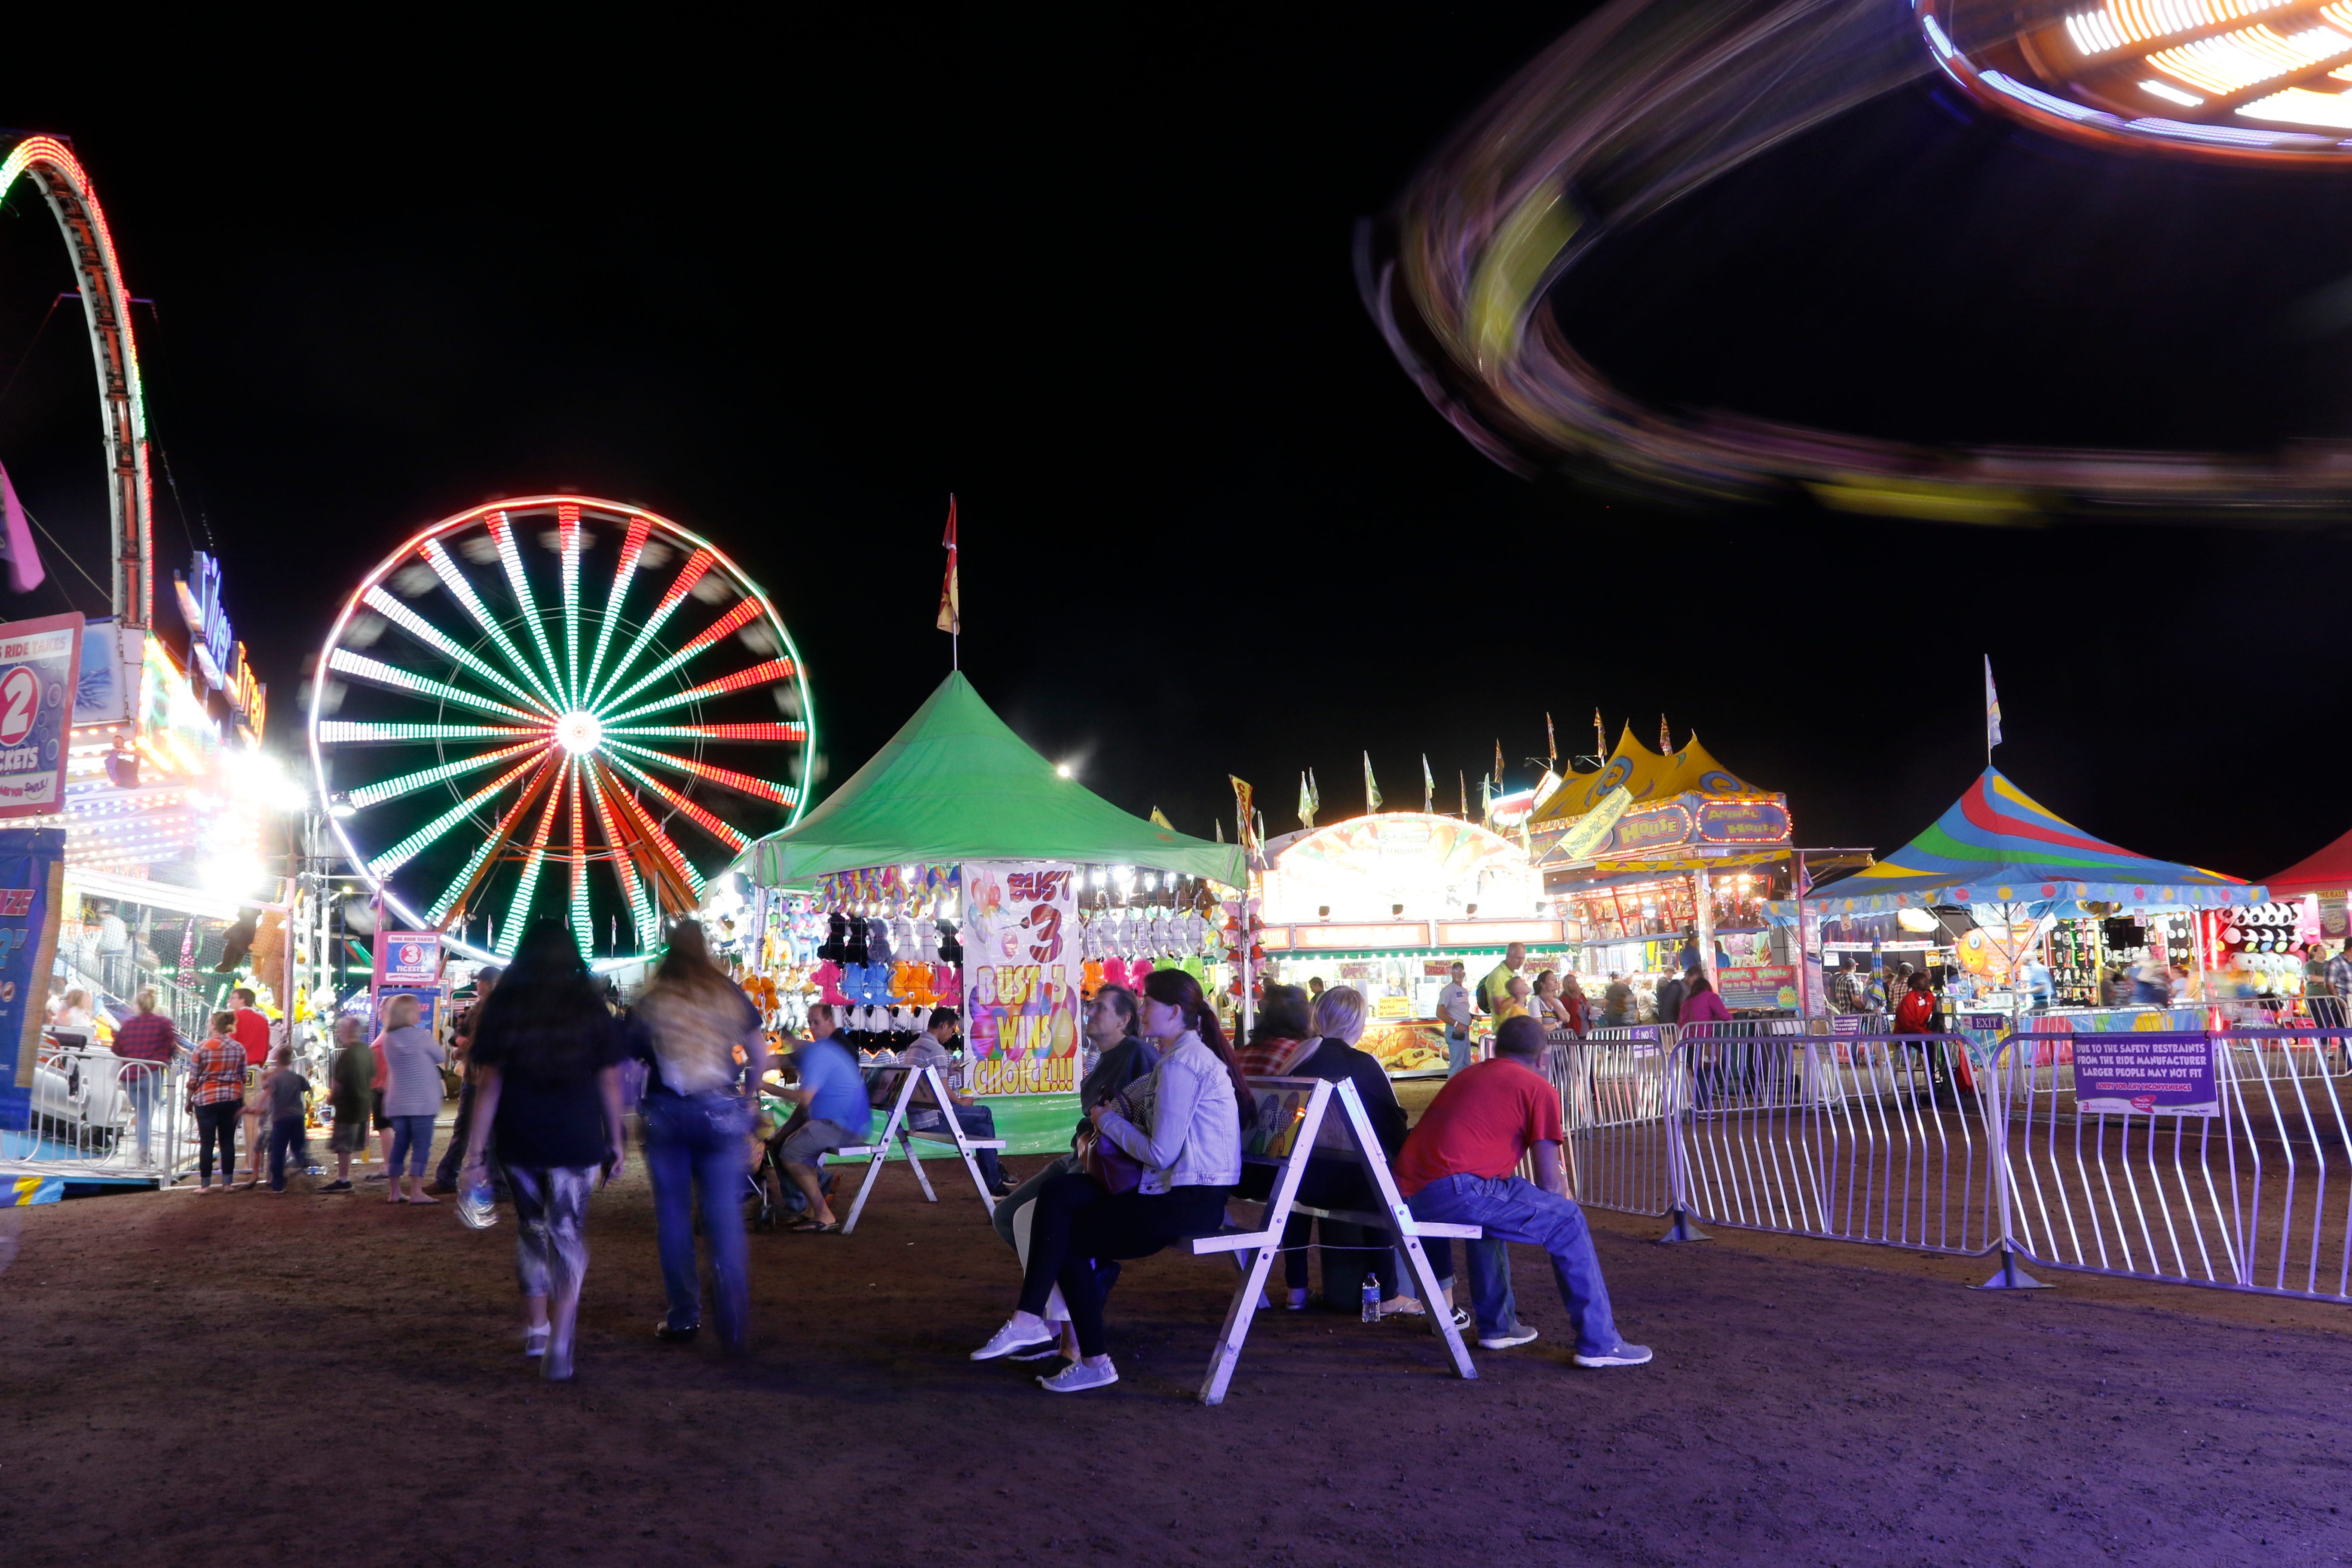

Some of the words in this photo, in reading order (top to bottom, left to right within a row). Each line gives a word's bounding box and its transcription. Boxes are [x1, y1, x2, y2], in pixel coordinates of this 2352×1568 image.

[5, 642, 29, 658] RIDE
[32, 636, 66, 654] TAKES
[1, 672, 32, 736] 2
[0, 747, 39, 772] CKETS
[1567, 790, 1627, 854] LEMONADE
[1708, 809, 1758, 820] ANIMAL
[1619, 818, 1677, 844] HOUSE
[1727, 824, 1777, 834] HOUSE
[1007, 871, 1073, 902] BUST
[2330, 890, 2346, 898] BALL
[1029, 903, 1063, 963] 3
[1268, 931, 1286, 946] STICK
[404, 945, 419, 963] 3
[1720, 970, 1751, 980] ANIMAL
[1757, 969, 1787, 979] HOUSE
[977, 965, 1041, 1007] BUST
[1052, 965, 1067, 1004] 3
[895, 1023, 906, 1031] Won
[1975, 1018, 1998, 1028] EXIT
[996, 1014, 1053, 1050] WINS
[1641, 1030, 1649, 1039] NO
[2076, 1044, 2090, 1053] DUE
[2092, 1044, 2101, 1053] TO
[2103, 1044, 2117, 1053] THE
[2120, 1044, 2150, 1053] SAFETY
[2153, 1043, 2205, 1053] RESTRAINTS
[2077, 1056, 2098, 1065] FROM
[2100, 1056, 2113, 1065] THE
[2116, 1056, 2135, 1065] RIDE
[2137, 1056, 2206, 1065] MANUFACTURER
[974, 1057, 1074, 1095] CHOICE!!!
[2082, 1067, 2113, 1077] LARGER
[2116, 1068, 2145, 1077] PEOPLE
[2147, 1068, 2168, 1077] MAY
[2170, 1068, 2187, 1077] NOT
[2190, 1068, 2202, 1078] FIT
[2142, 1082, 2192, 1092] INCONVENIENCE
